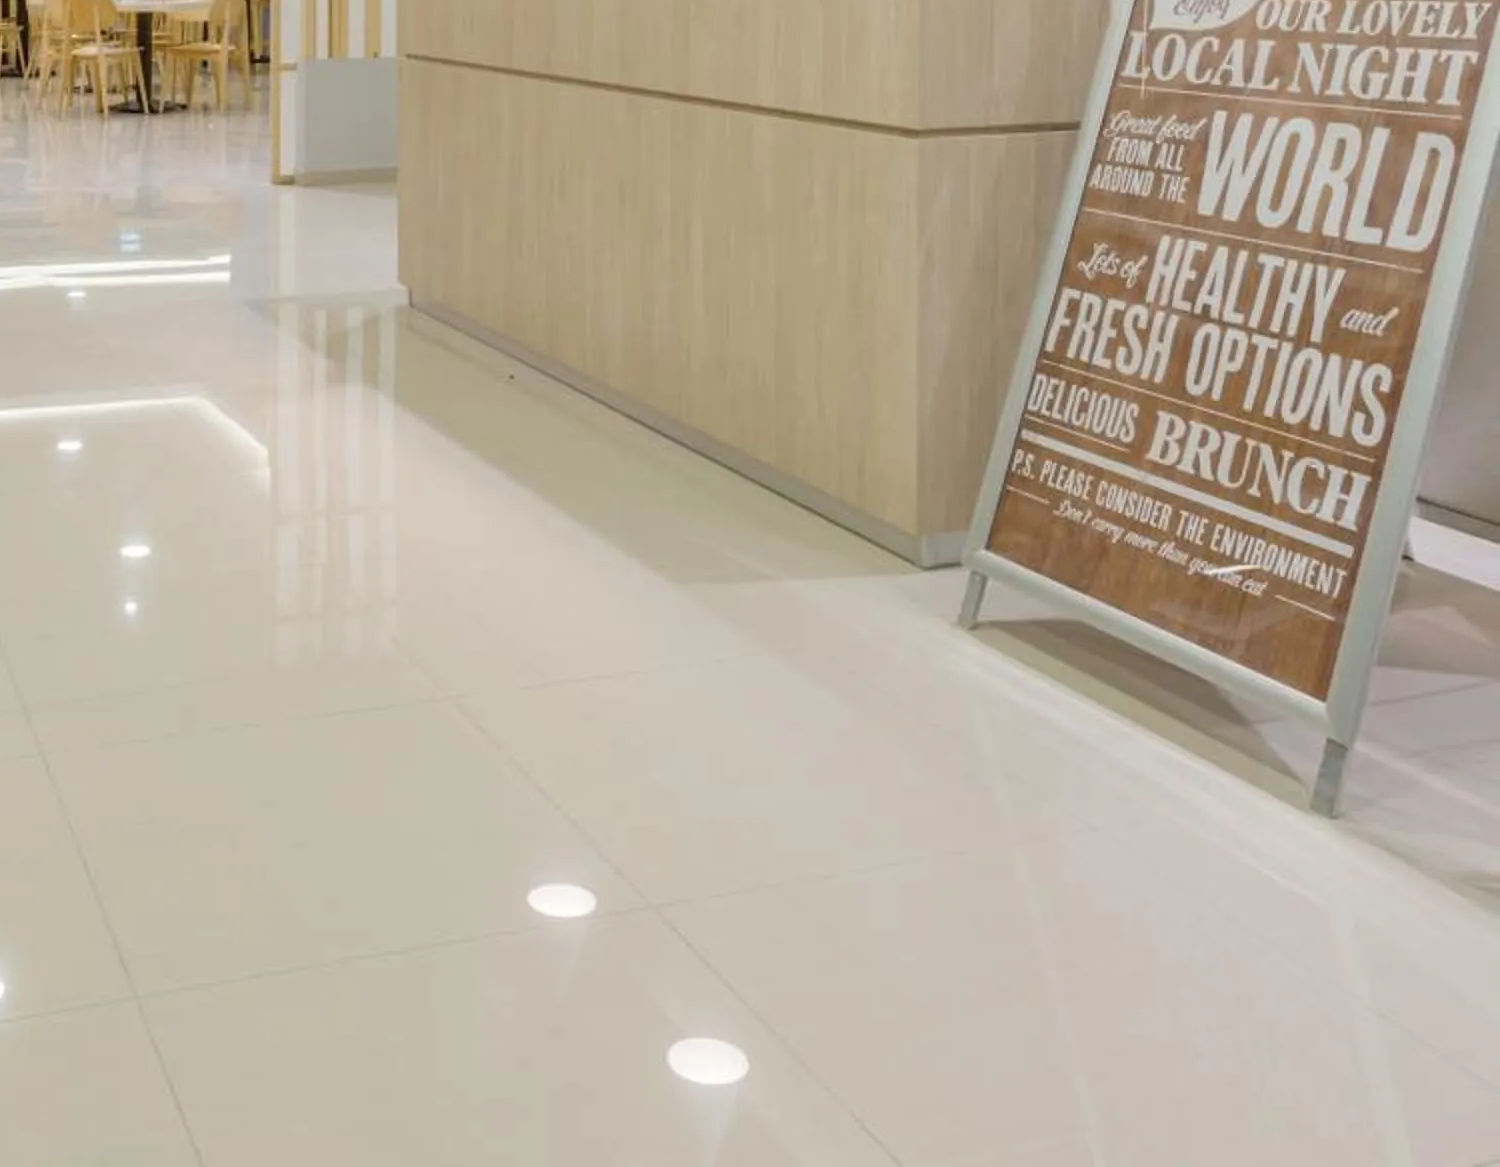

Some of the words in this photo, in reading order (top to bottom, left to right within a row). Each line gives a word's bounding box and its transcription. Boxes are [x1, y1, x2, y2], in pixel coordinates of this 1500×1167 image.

[1119, 31, 1280, 91] LOCAL
[1287, 41, 1481, 106] NIGHT
[1103, 110, 1162, 137] Great
[1156, 114, 1208, 144] food
[1107, 137, 1154, 166] FROM
[1155, 142, 1184, 172] ALL
[1197, 109, 1456, 252] WORLD
[1089, 164, 1155, 198] AROUND
[1158, 174, 1191, 204] THE
[1120, 255, 1149, 289] of
[1145, 235, 1347, 343] HEALTHY
[1340, 307, 1399, 337] and
[1044, 288, 1180, 384] FRESH
[1185, 323, 1394, 447] OPTIONS
[1027, 373, 1140, 444] DELICIOUS
[1145, 410, 1373, 531] BRUNCH
[1011, 449, 1035, 480] P.S.
[1039, 460, 1095, 501] PLEASE
[1095, 480, 1174, 531] CONSIDER
[1176, 510, 1209, 545] THE
[1209, 523, 1348, 599] ENVIRONMENT
